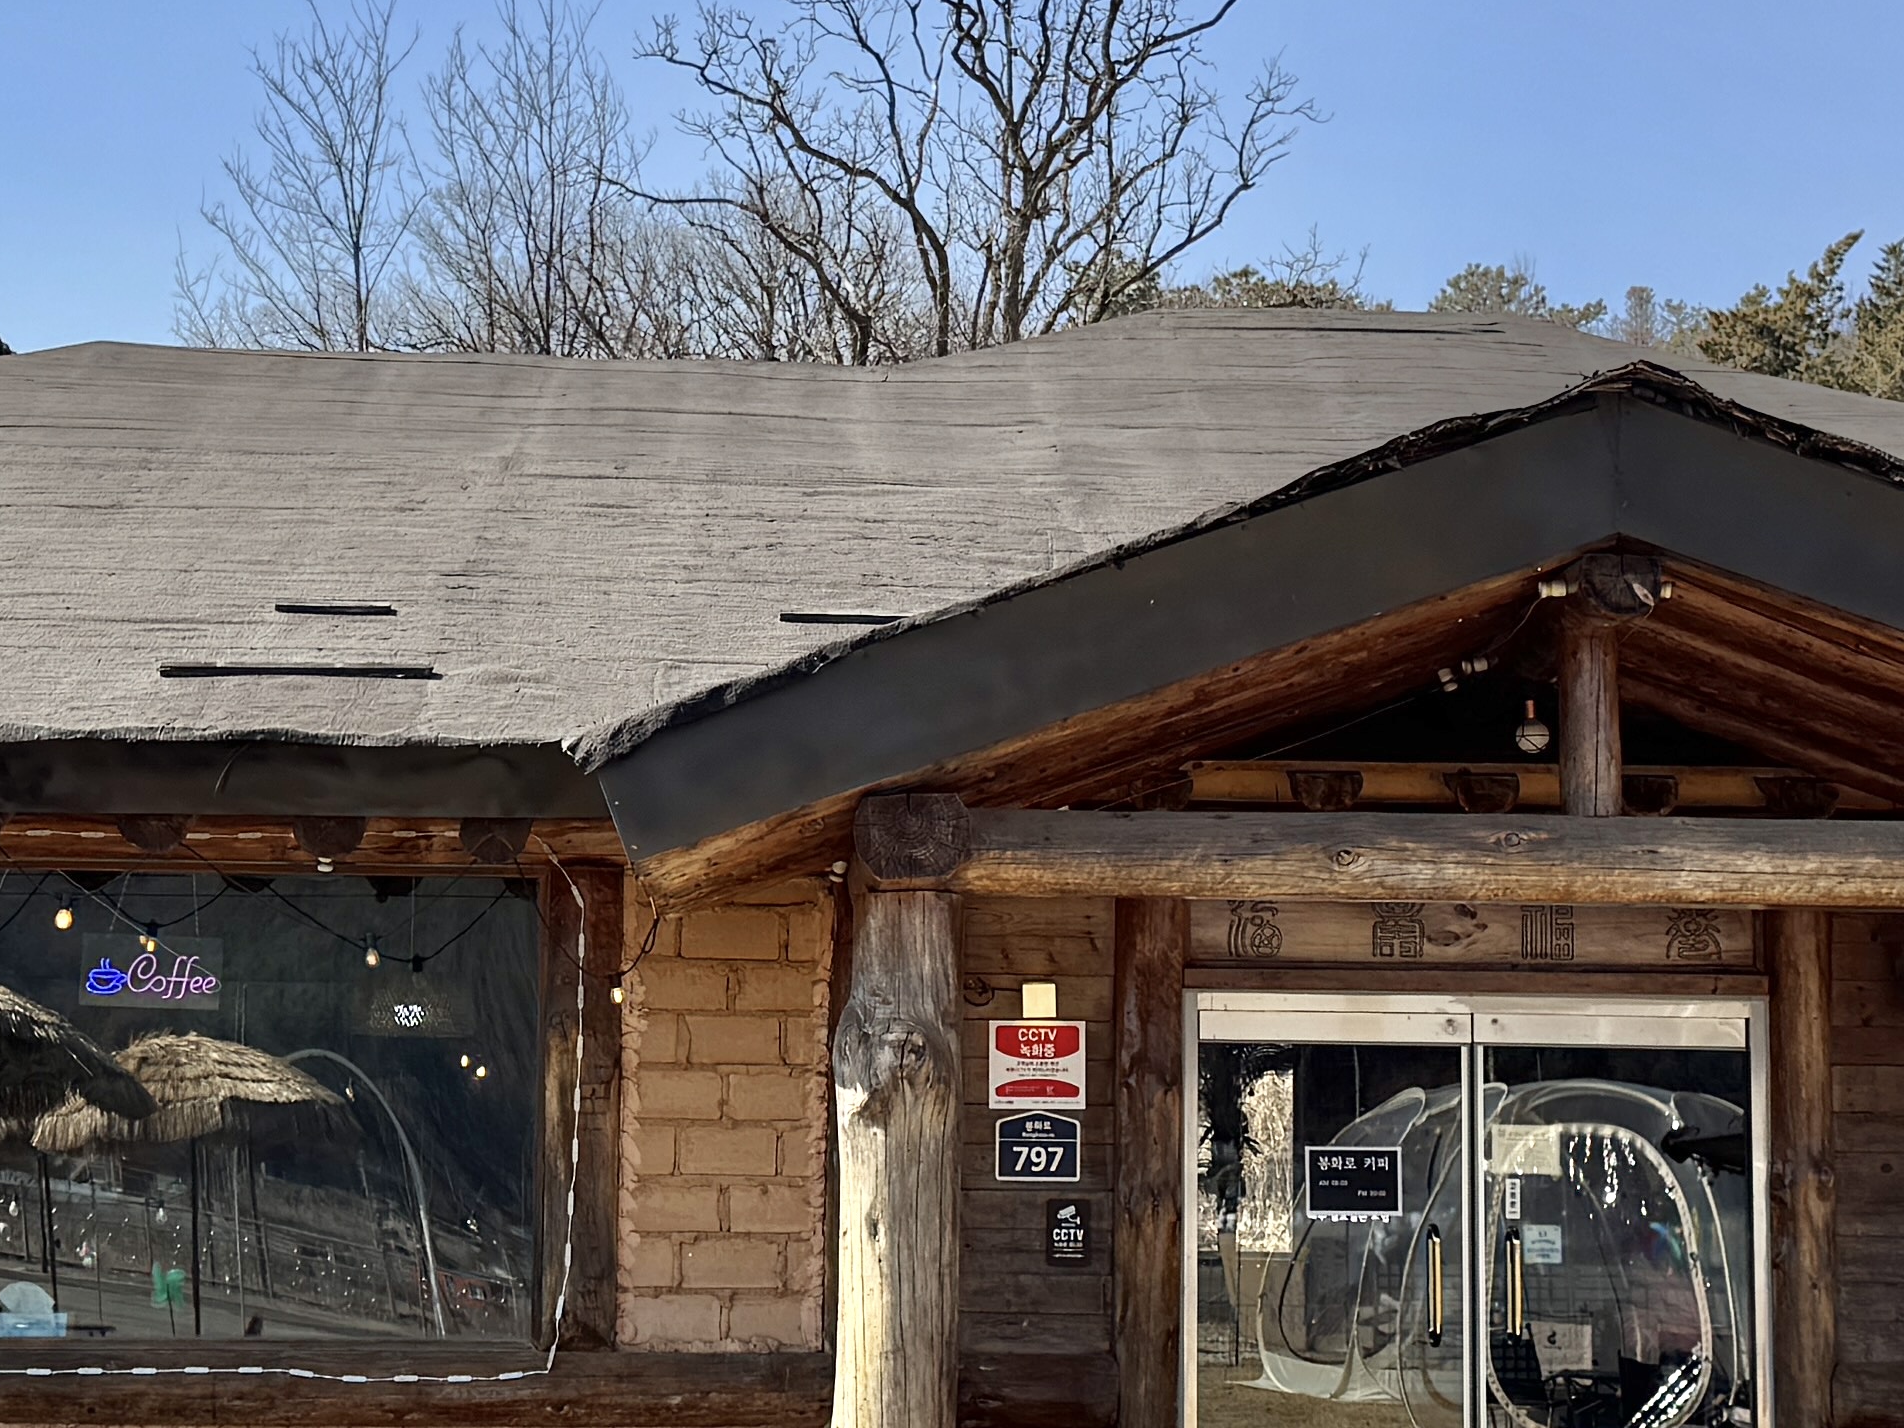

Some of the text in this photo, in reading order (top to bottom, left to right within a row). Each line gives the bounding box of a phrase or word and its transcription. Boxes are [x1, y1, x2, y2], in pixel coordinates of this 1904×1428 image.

[127, 953, 217, 999] Coffee
[1018, 1028, 1057, 1042] CCTV
[1019, 1043, 1056, 1058] 녹화중
[1013, 1146, 1064, 1172] 797
[1317, 1156, 1389, 1171] 봉화로 커피
[1052, 1228, 1084, 1241] CCTV
